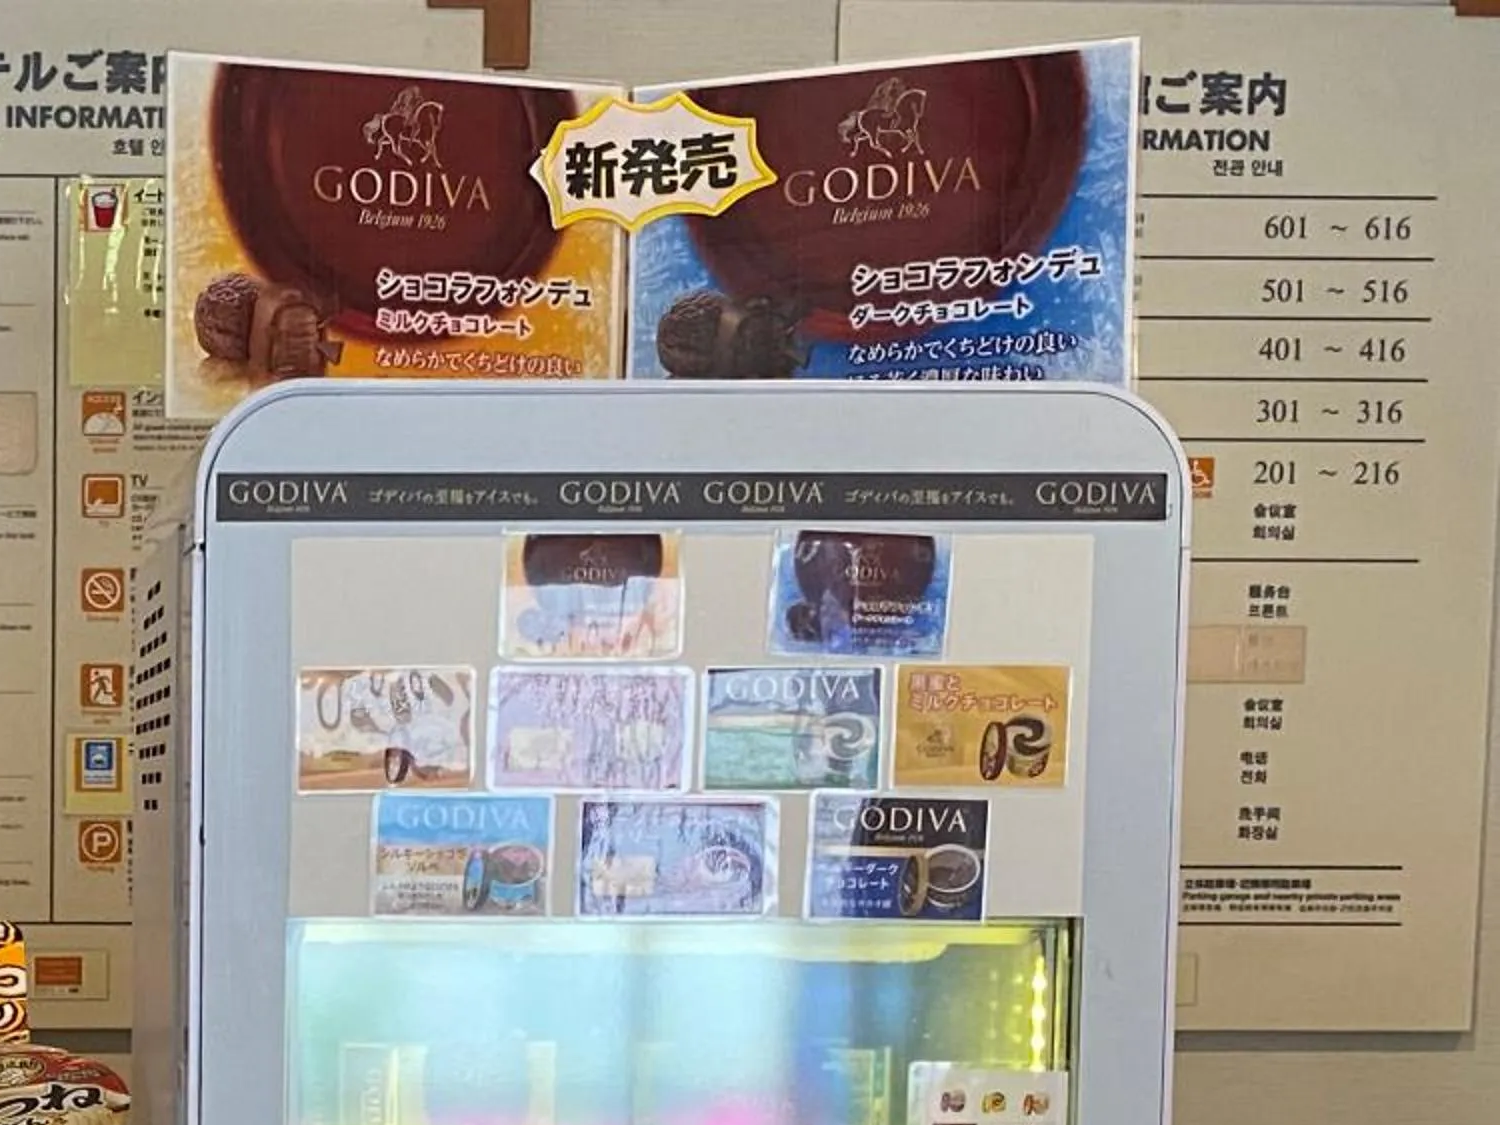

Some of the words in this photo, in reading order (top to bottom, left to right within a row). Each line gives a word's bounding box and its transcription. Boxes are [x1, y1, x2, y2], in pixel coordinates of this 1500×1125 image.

[1141, 71, 1287, 116] ご案内
[565, 132, 739, 198] 新発売
[312, 165, 490, 211] GODIVA
[783, 157, 981, 206] GODIVA
[358, 209, 412, 229] Belgium
[416, 213, 446, 231] 1926
[832, 206, 893, 225] Belgium
[897, 203, 930, 219] 1926
[1265, 217, 1307, 239] 601
[1365, 217, 1411, 239] 616
[851, 250, 1100, 295] ショコラフォンデュ
[377, 268, 592, 309] ショコラフォンデュ
[1262, 280, 1304, 303] 501
[1363, 280, 1408, 303] 516
[376, 311, 532, 337] ミルクチョコレート
[849, 297, 1033, 328] ダークチョコレート
[848, 333, 1078, 362] なめらかでくちどけの良い
[1259, 338, 1301, 362] 401
[1360, 338, 1405, 362] 416
[375, 347, 582, 376] なめらかでくちどけの良い
[1256, 400, 1299, 423] 301
[1356, 400, 1403, 423] 316
[131, 474, 148, 487] TV
[1253, 461, 1296, 484] 201
[1354, 461, 1399, 484] 216
[228, 479, 347, 504] GODIVA
[560, 479, 680, 504] GODIVA
[703, 480, 823, 504] GODIVA
[1036, 480, 1155, 505] GODIVA
[726, 675, 861, 699] GODIVA
[396, 802, 531, 829] GODIVA
[834, 806, 967, 832] GODIVA
